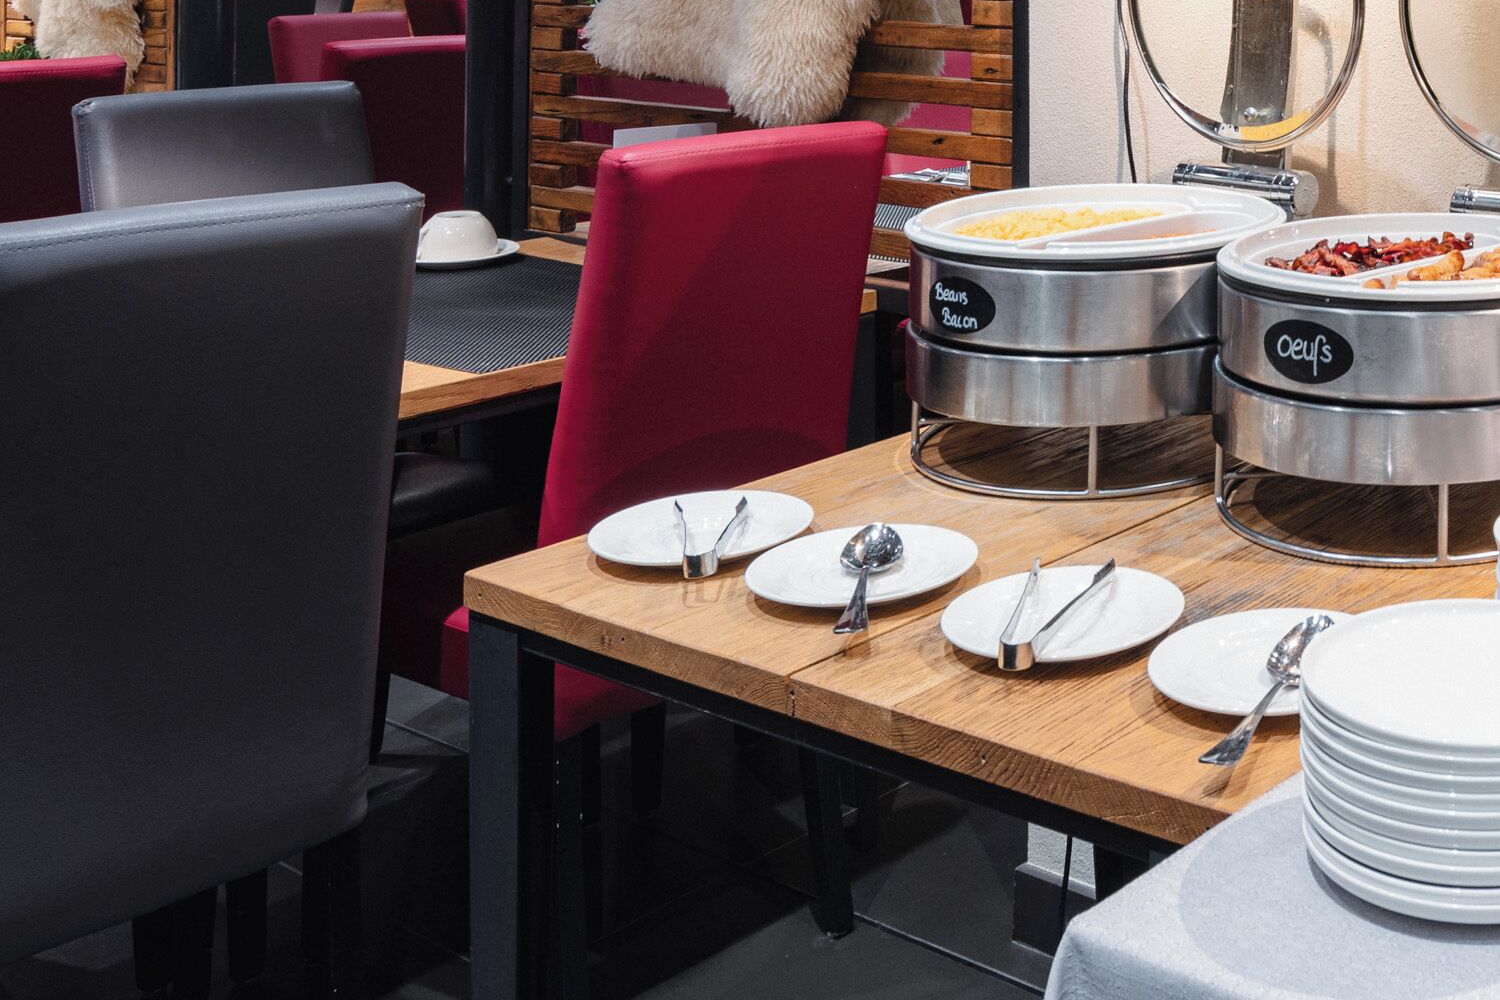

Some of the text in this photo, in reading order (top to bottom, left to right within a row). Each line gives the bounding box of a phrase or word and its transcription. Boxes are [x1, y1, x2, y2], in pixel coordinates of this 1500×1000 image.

[935, 281, 969, 305] Beans
[941, 306, 978, 329] Bacon
[1276, 333, 1333, 377] Oeufs
